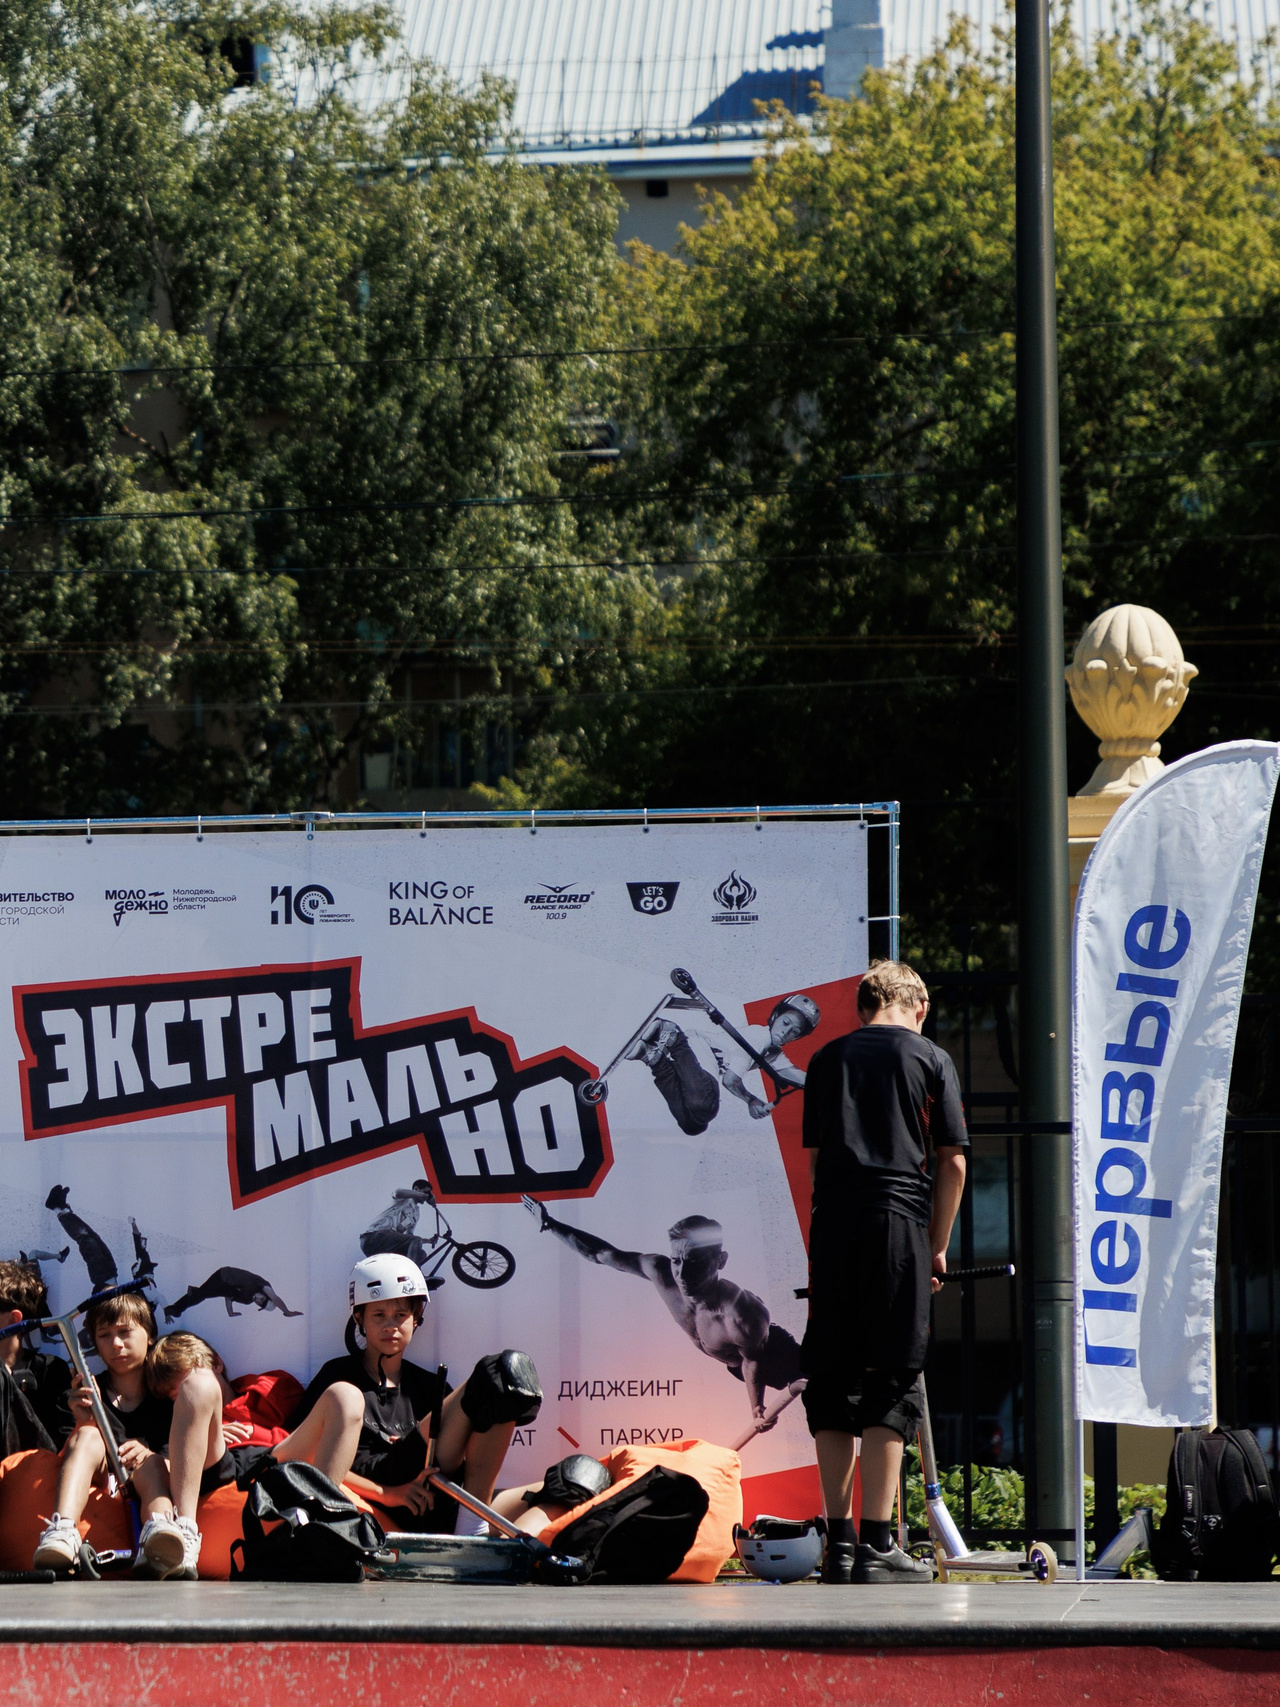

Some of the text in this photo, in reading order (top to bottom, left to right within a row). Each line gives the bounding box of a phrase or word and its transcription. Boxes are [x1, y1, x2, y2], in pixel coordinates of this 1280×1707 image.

[172, 895, 237, 903] Нижегородской
[389, 881, 475, 899] KING OF
[524, 894, 591, 904] RECORD
[642, 886, 664, 895] LET'S
[640, 896, 667, 911] GO
[546, 912, 567, 920] 100.9
[41, 988, 337, 1110] ЭКСТРЕ
[251, 1037, 498, 1171] МАЛЬ
[438, 1075, 586, 1176] НО
[1083, 904, 1192, 1368] Первые
[557, 1379, 684, 1401] ДИДЖЕИНГ
[600, 1428, 684, 1446] ПАРКУР
